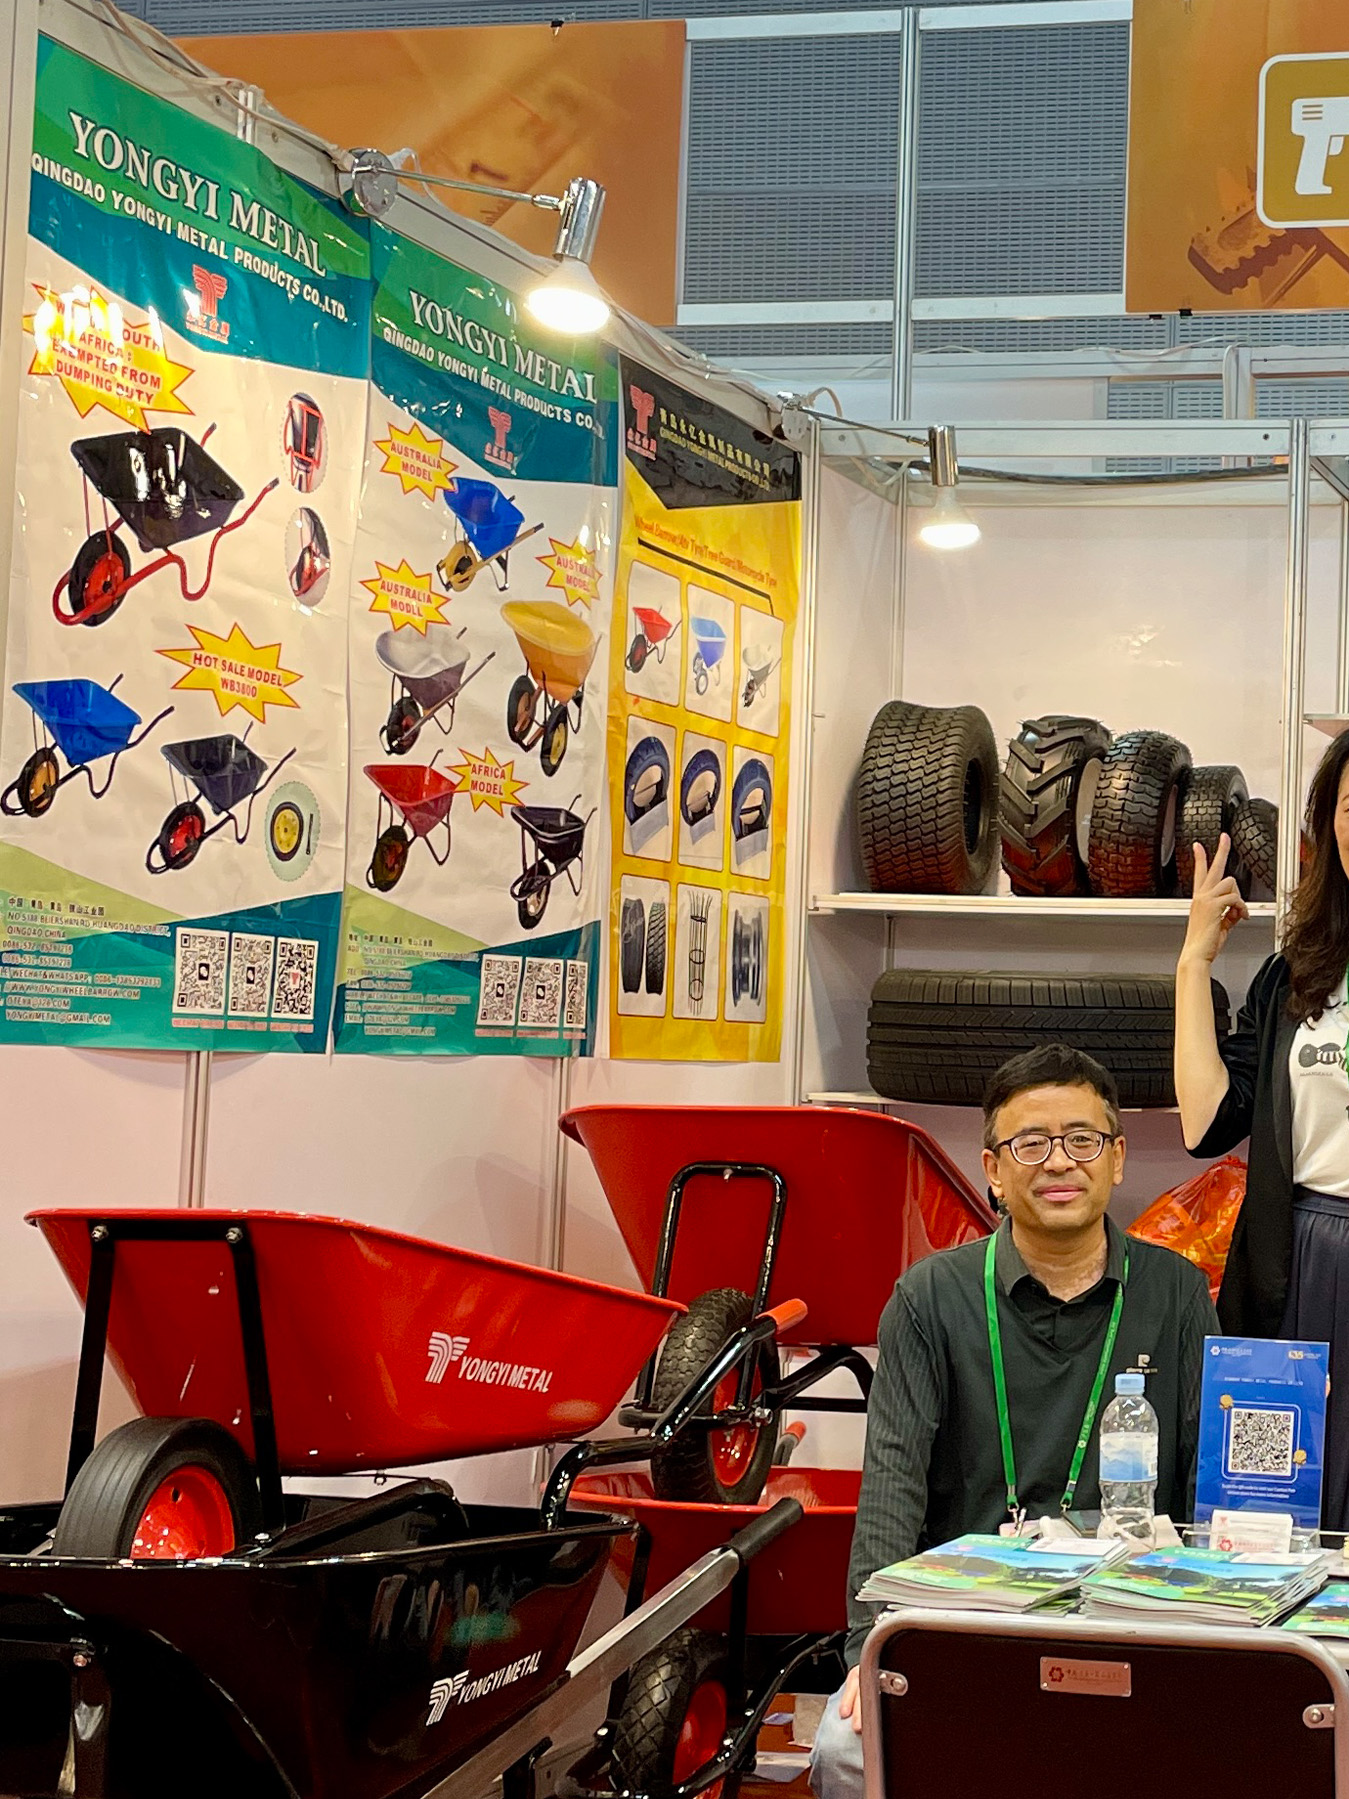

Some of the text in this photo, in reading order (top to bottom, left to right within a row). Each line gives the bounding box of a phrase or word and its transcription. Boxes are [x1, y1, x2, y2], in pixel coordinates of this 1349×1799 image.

[69, 112, 326, 277] YONGYI METAL
[31, 153, 106, 203] QINGDAO
[111, 190, 172, 235] YONGYI
[177, 221, 229, 260] METAL
[234, 247, 300, 296] PRODUCTS
[121, 329, 161, 352] OUTH
[409, 289, 598, 404] YONGYI METAL
[56, 359, 154, 405] DUMPING DUTY
[121, 365, 161, 389] FROM
[383, 326, 435, 362] QINGDAO
[437, 351, 479, 383] YONGYI
[480, 370, 512, 400] METAL
[514, 388, 572, 424] PRODUCTS
[390, 441, 442, 470] AUSTRALIA
[401, 462, 433, 483] MODEL
[380, 579, 433, 604] AUSTRALIA
[193, 652, 283, 687] HOT SALE MODEL
[470, 763, 507, 780] AFRICA
[470, 779, 504, 796] MODEL
[458, 1356, 553, 1393] YONGYI METAL
[457, 1650, 542, 1705] YONGYI METAL
